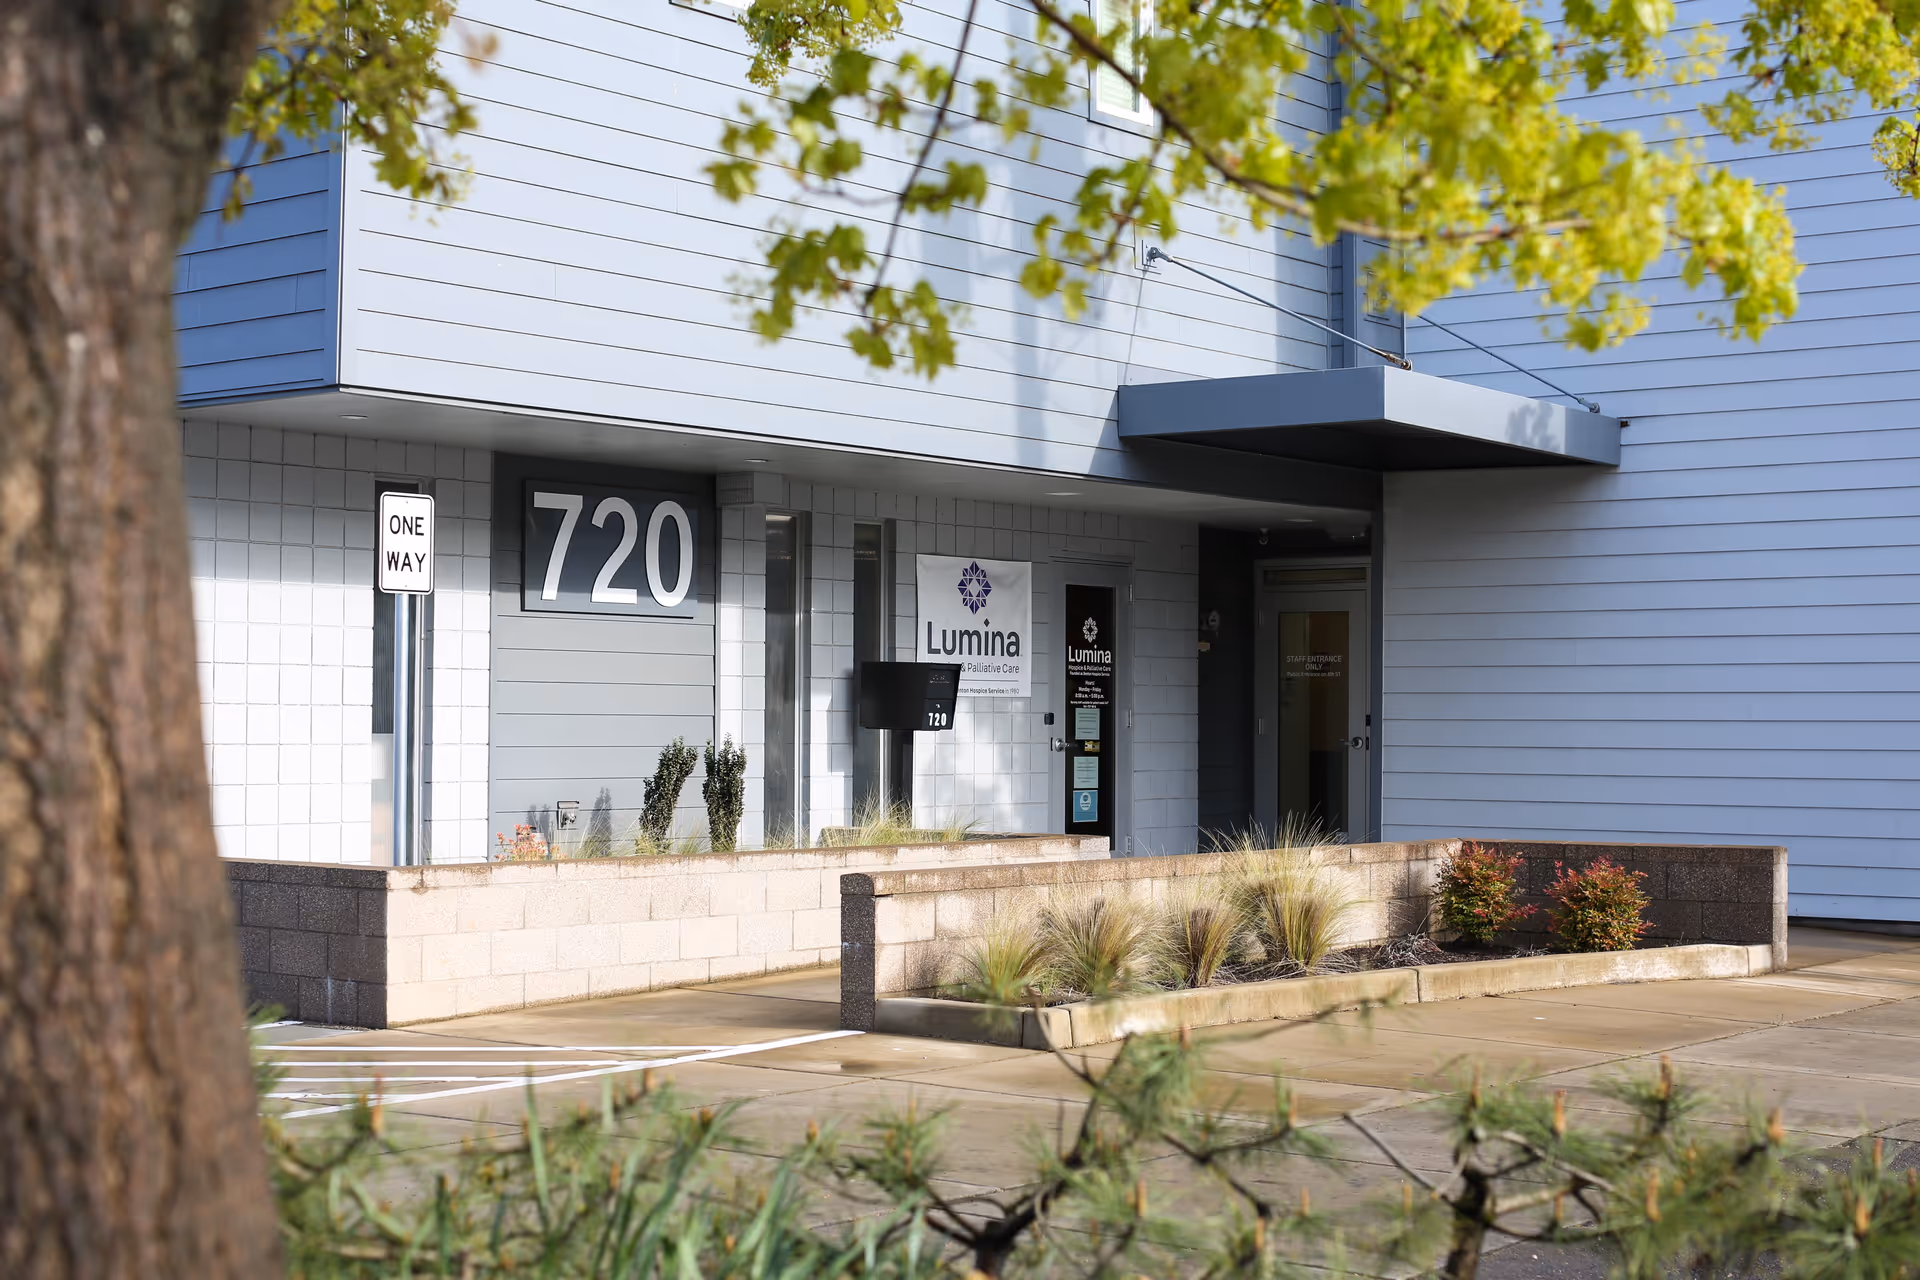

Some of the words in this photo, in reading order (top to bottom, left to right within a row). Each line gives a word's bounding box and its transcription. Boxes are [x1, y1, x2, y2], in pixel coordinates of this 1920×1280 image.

[389, 514, 425, 537] ONE
[533, 491, 694, 608] 720
[386, 550, 427, 573] WAY
[927, 618, 1020, 658] Lumina
[1068, 644, 1111, 664] Lumina
[1286, 655, 1306, 663] STAFF
[1307, 655, 1342, 663] ENTRANCE
[960, 662, 966, 673] &
[967, 662, 1001, 674] Palliative
[1002, 663, 1020, 674] Care
[969, 687, 987, 695] Hospice
[928, 712, 947, 727] 720
